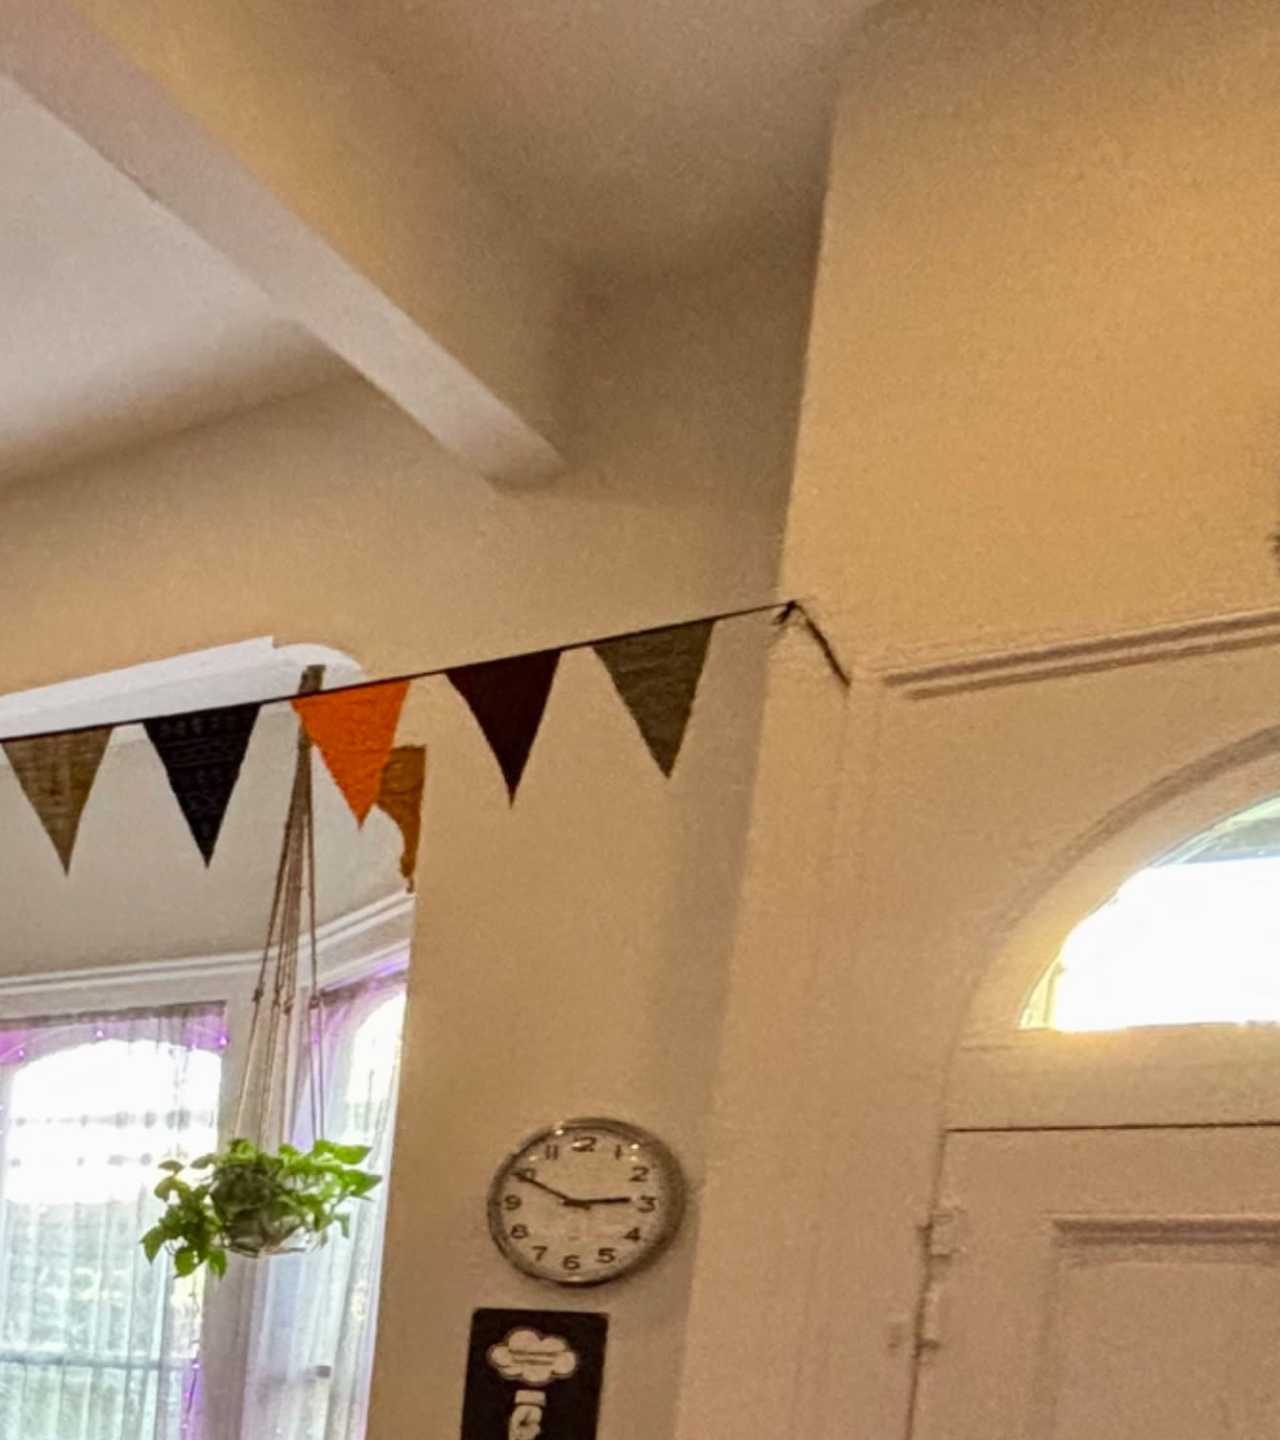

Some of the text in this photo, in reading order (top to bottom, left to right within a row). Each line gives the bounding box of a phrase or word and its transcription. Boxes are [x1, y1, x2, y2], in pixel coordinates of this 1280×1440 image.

[545, 1145, 558, 1160] 11
[614, 1145, 621, 1159] 1
[629, 1166, 649, 1182] 2
[504, 1195, 521, 1210] 9
[638, 1196, 656, 1214] 3
[510, 1225, 528, 1239] 8
[624, 1228, 640, 1241] 4
[532, 1246, 547, 1261] 7
[597, 1248, 616, 1263] 5
[563, 1255, 580, 1270] 6
